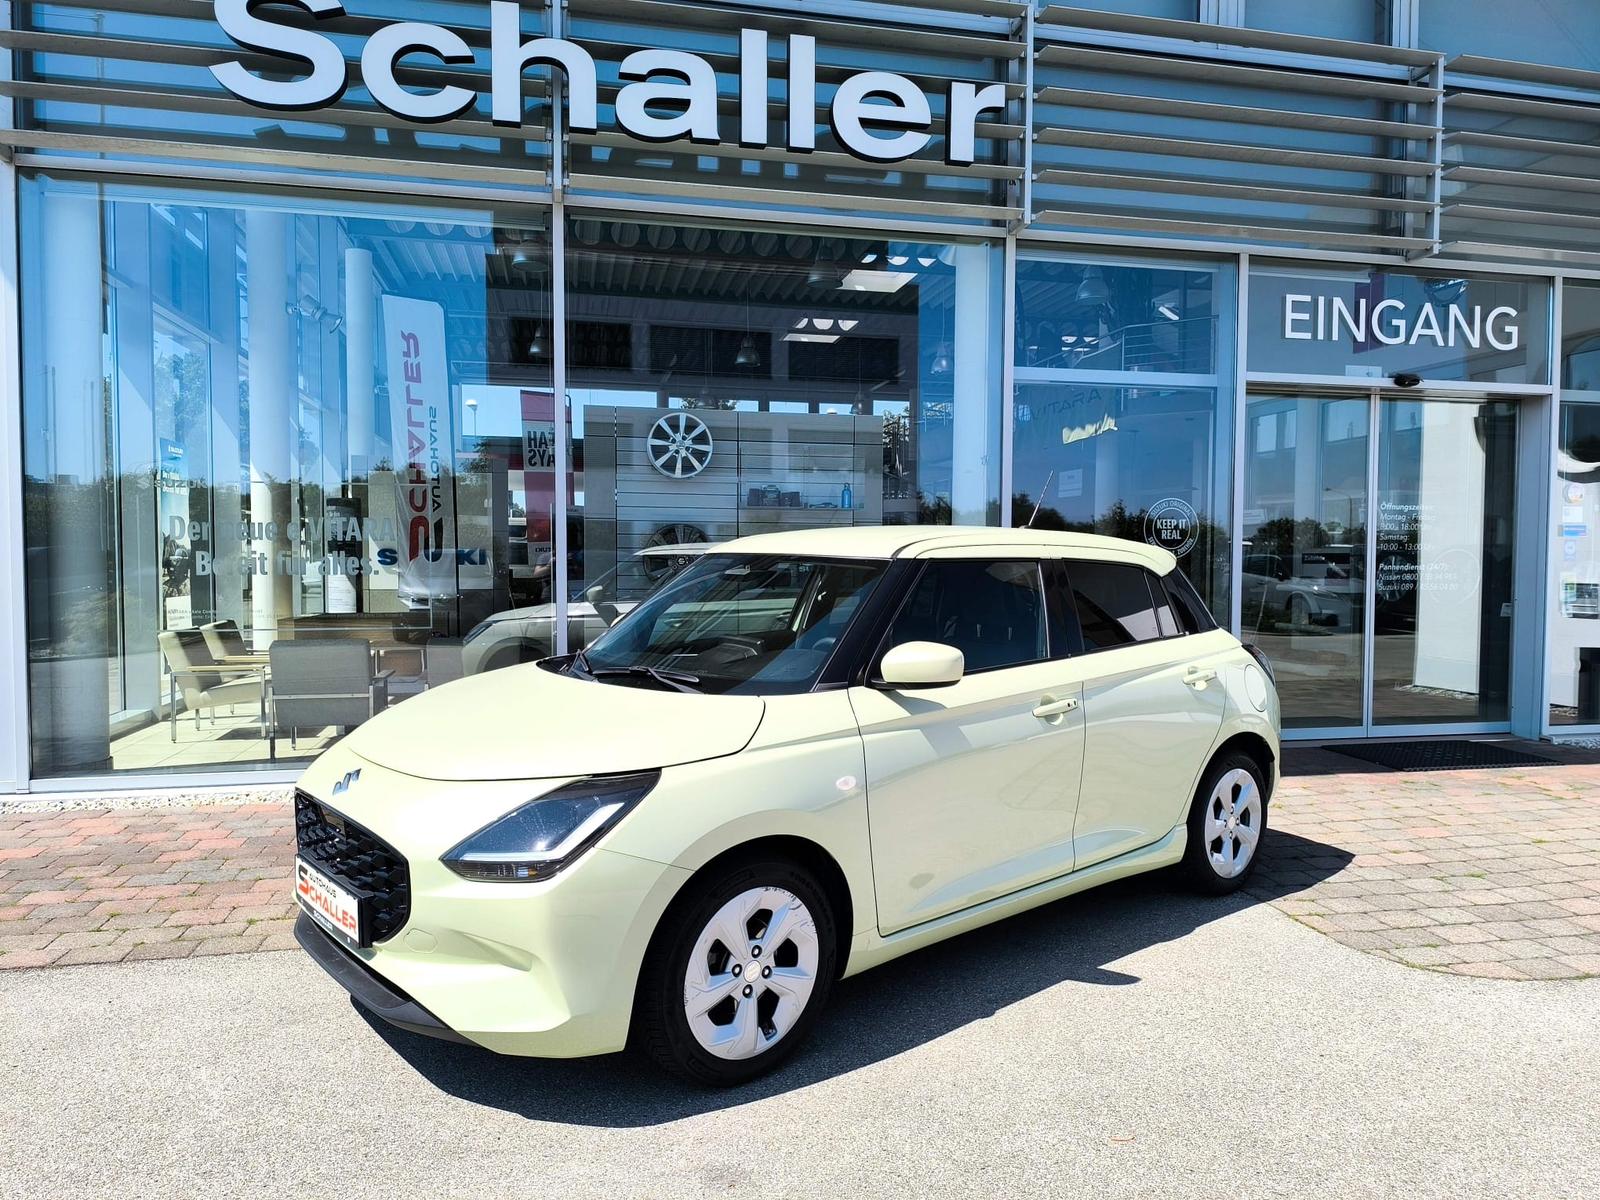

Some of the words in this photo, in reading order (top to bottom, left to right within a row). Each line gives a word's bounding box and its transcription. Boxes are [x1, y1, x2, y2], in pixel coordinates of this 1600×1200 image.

[208, 0, 1005, 164] Schaller
[1284, 293, 1519, 351] EINGANG
[168, 515, 211, 541] Der
[306, 516, 396, 541] VITARA
[1156, 518, 1177, 530] KEEP
[1178, 518, 1187, 530] IT
[1380, 513, 1406, 523] Montag
[1161, 529, 1182, 540] REAL
[298, 864, 357, 935] SCHALLER
